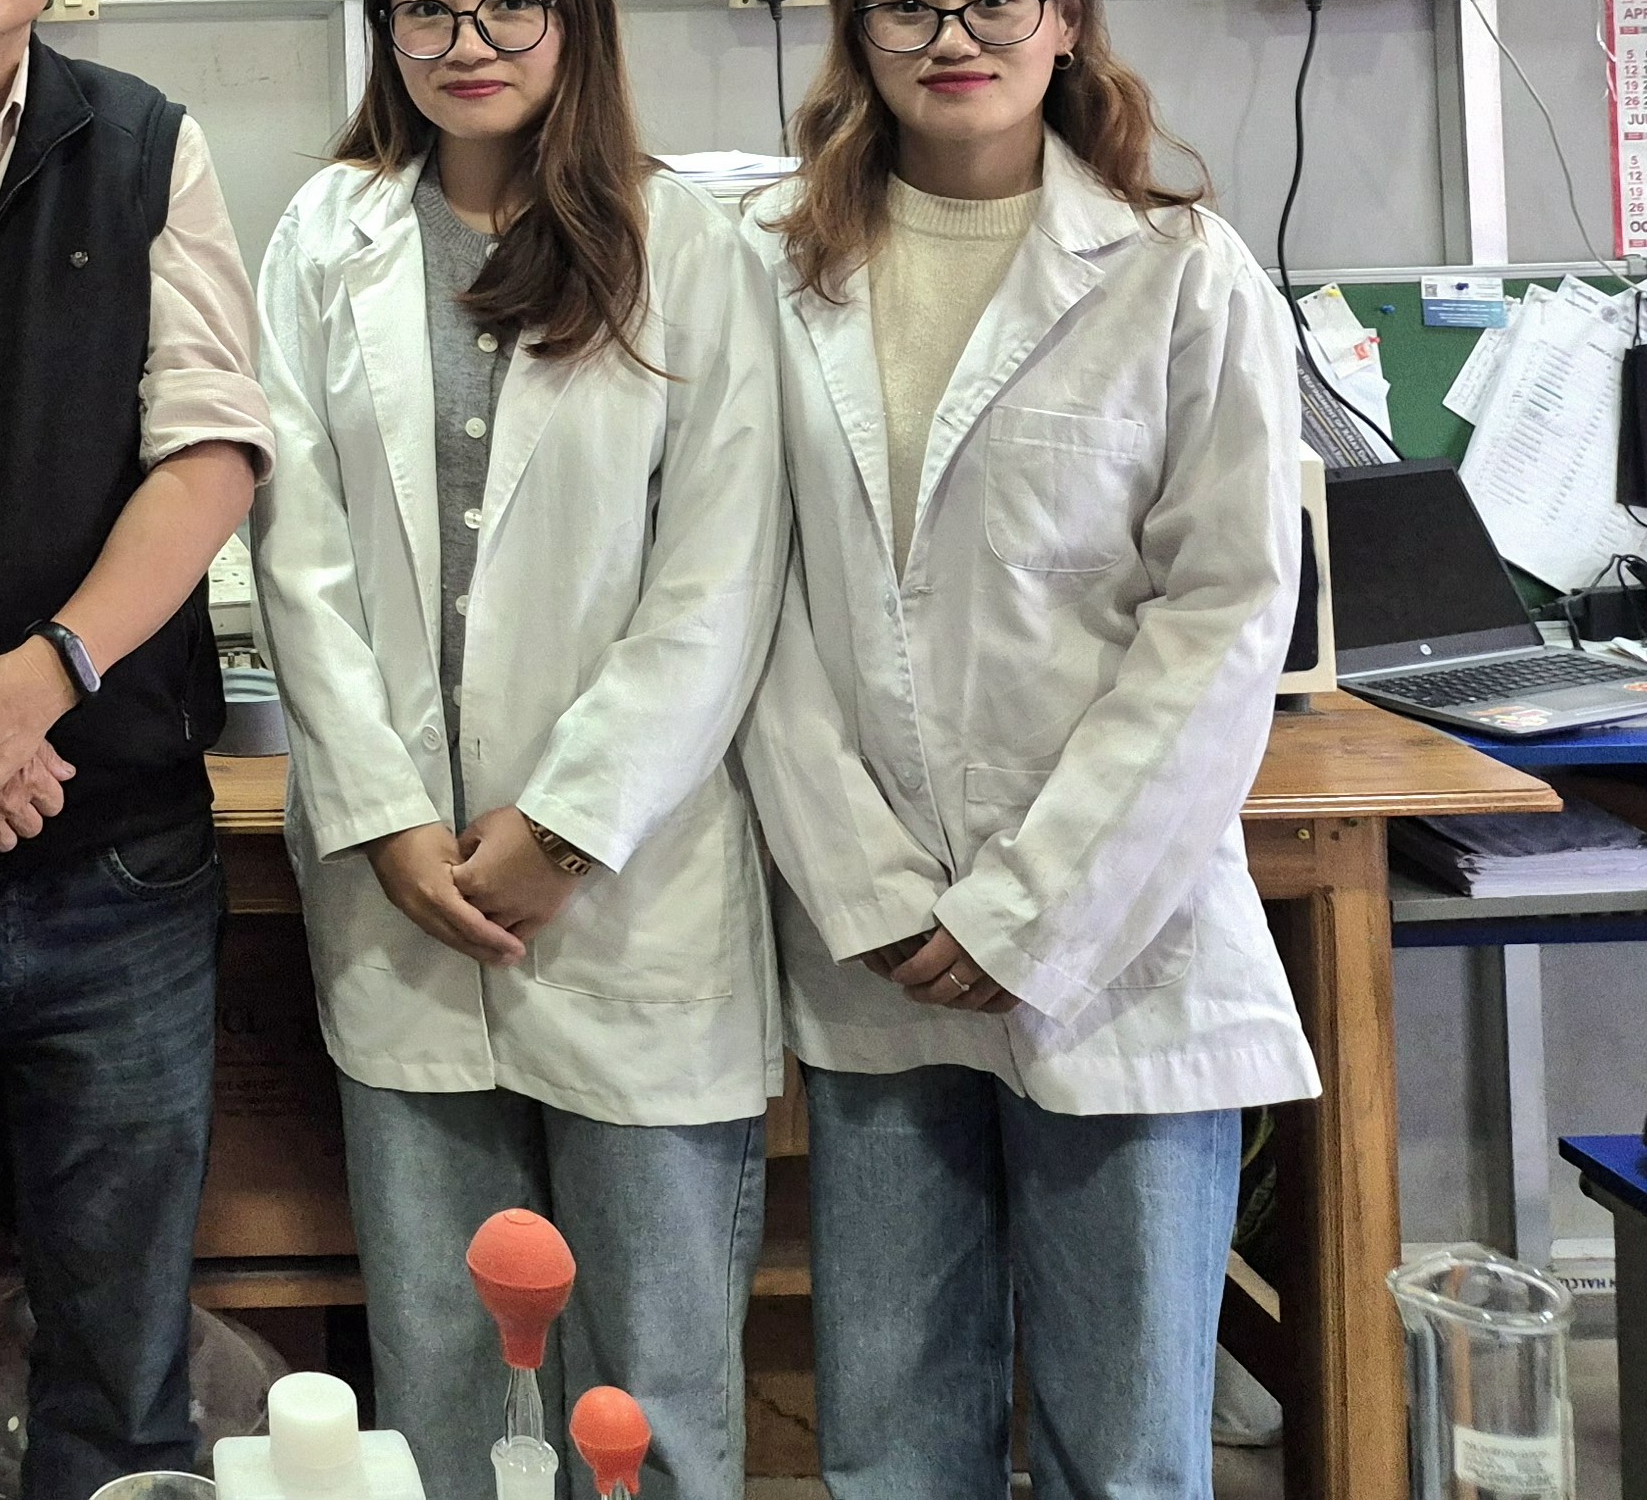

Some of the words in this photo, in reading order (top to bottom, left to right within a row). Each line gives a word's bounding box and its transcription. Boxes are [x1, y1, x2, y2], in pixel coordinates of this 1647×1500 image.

[1626, 49, 1634, 59] 5
[1624, 65, 1638, 75] 12
[1624, 81, 1639, 91] 19
[1624, 96, 1640, 106] 26
[1627, 113, 1647, 125] JU
[1630, 155, 1639, 165] 5
[1628, 171, 1643, 181] 12
[1628, 187, 1643, 197] 19
[1628, 202, 1645, 213] 26
